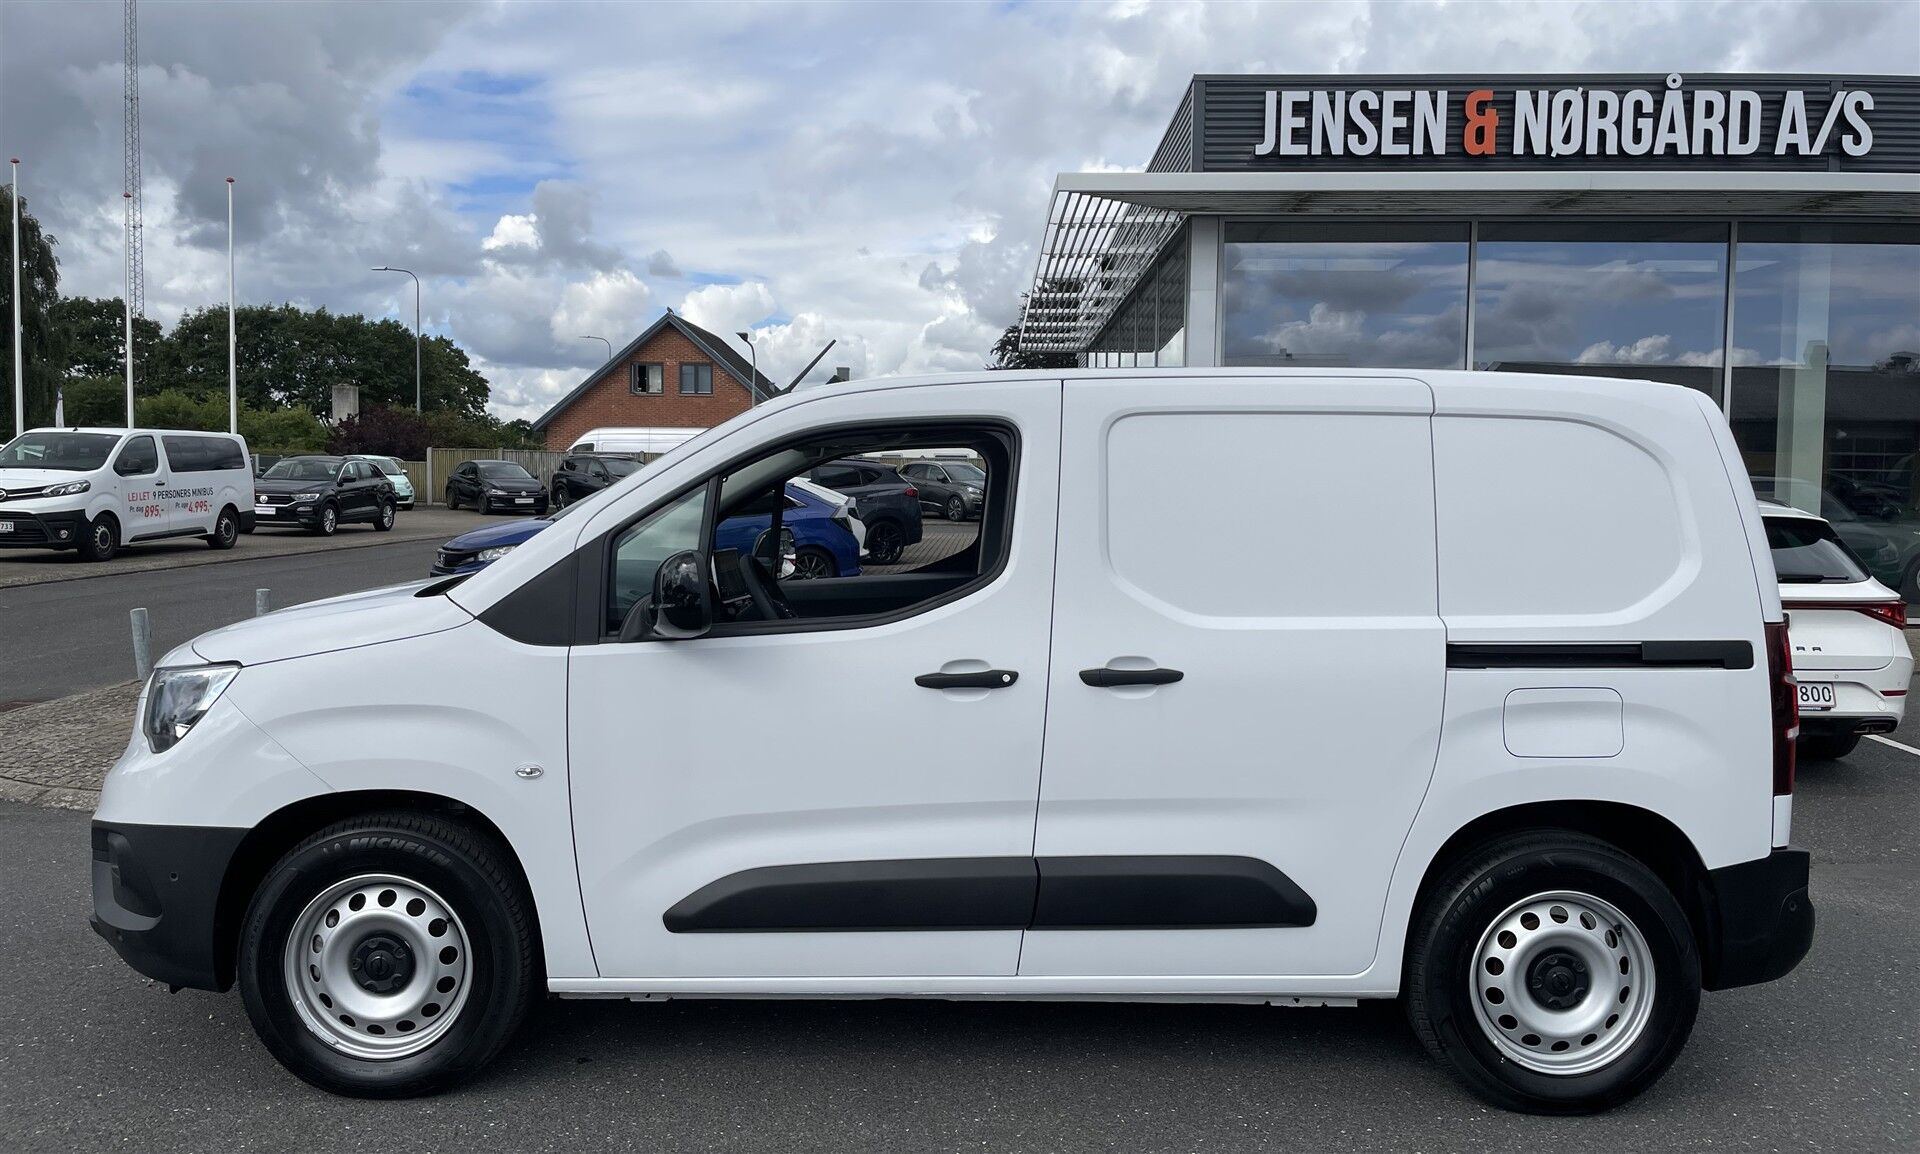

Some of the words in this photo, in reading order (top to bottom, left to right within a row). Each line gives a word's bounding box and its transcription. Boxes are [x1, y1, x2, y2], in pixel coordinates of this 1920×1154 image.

[1254, 89, 1448, 157] JENSEN
[1463, 89, 1499, 156] &
[1513, 73, 1762, 158] NØRGÅRD
[1774, 89, 1875, 157] A/S
[139, 491, 150, 501] LET
[152, 491, 157, 500] 9
[158, 489, 191, 500] PERSONERS
[192, 487, 214, 497] MINIBUS
[144, 504, 165, 518] 895,-
[1799, 686, 1832, 702] 800
[349, 836, 451, 867] MICHELIN
